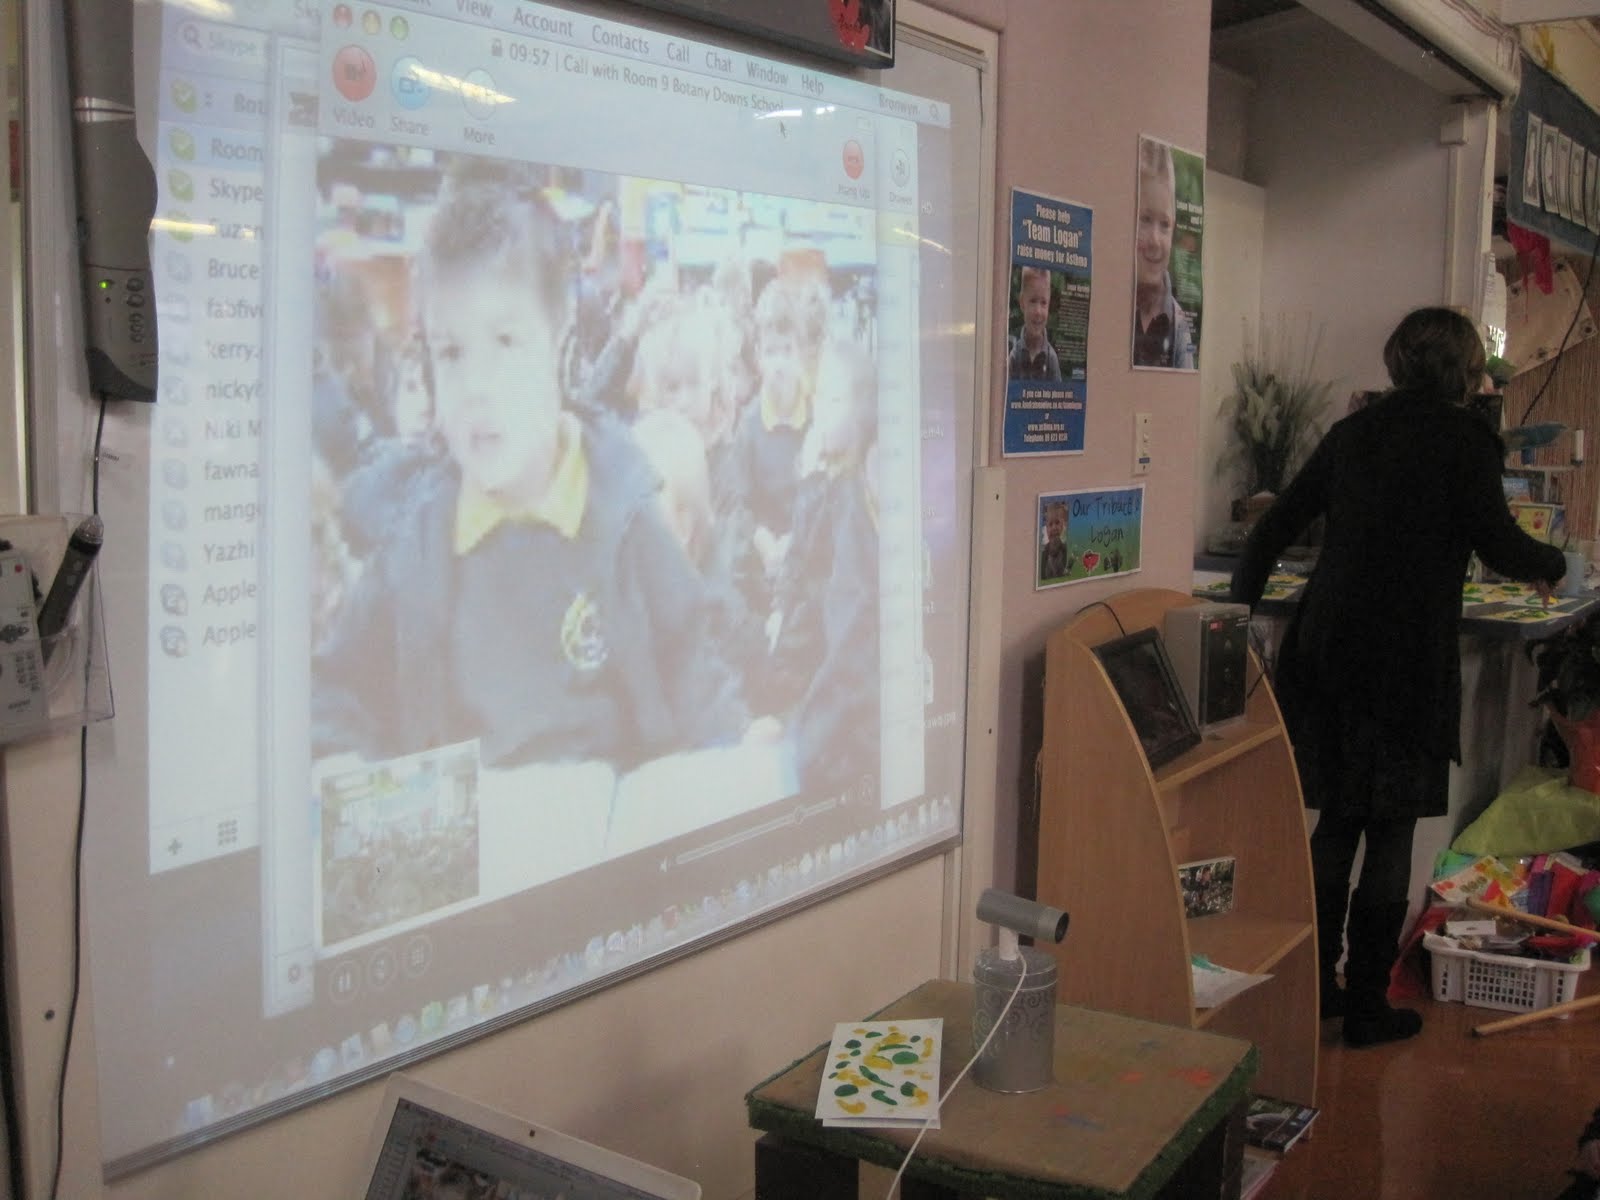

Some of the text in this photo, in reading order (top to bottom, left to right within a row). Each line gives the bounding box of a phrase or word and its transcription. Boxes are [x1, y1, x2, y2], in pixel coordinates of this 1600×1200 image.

[456, 0, 825, 97] View Account Contacts Call Chat Window Help
[509, 42, 550, 67] 09:57
[563, 54, 589, 75] Call
[592, 63, 619, 81] with
[623, 66, 658, 89] Room
[661, 74, 669, 91] 9
[673, 77, 711, 102] Botany
[712, 85, 749, 108] Downs
[750, 94, 784, 113] School
[332, 105, 497, 146] Video Share More
[210, 139, 264, 161] Room
[209, 177, 264, 201] Skype
[1036, 204, 1071, 225] Please help
[1017, 244, 1033, 257] raise
[1034, 247, 1054, 263] money
[1055, 250, 1065, 263] for
[208, 258, 259, 280] Bruce
[1072, 498, 1090, 518] Our
[1090, 524, 1124, 548] Logan
[203, 579, 257, 607] Apple
[202, 620, 257, 646] Apple
